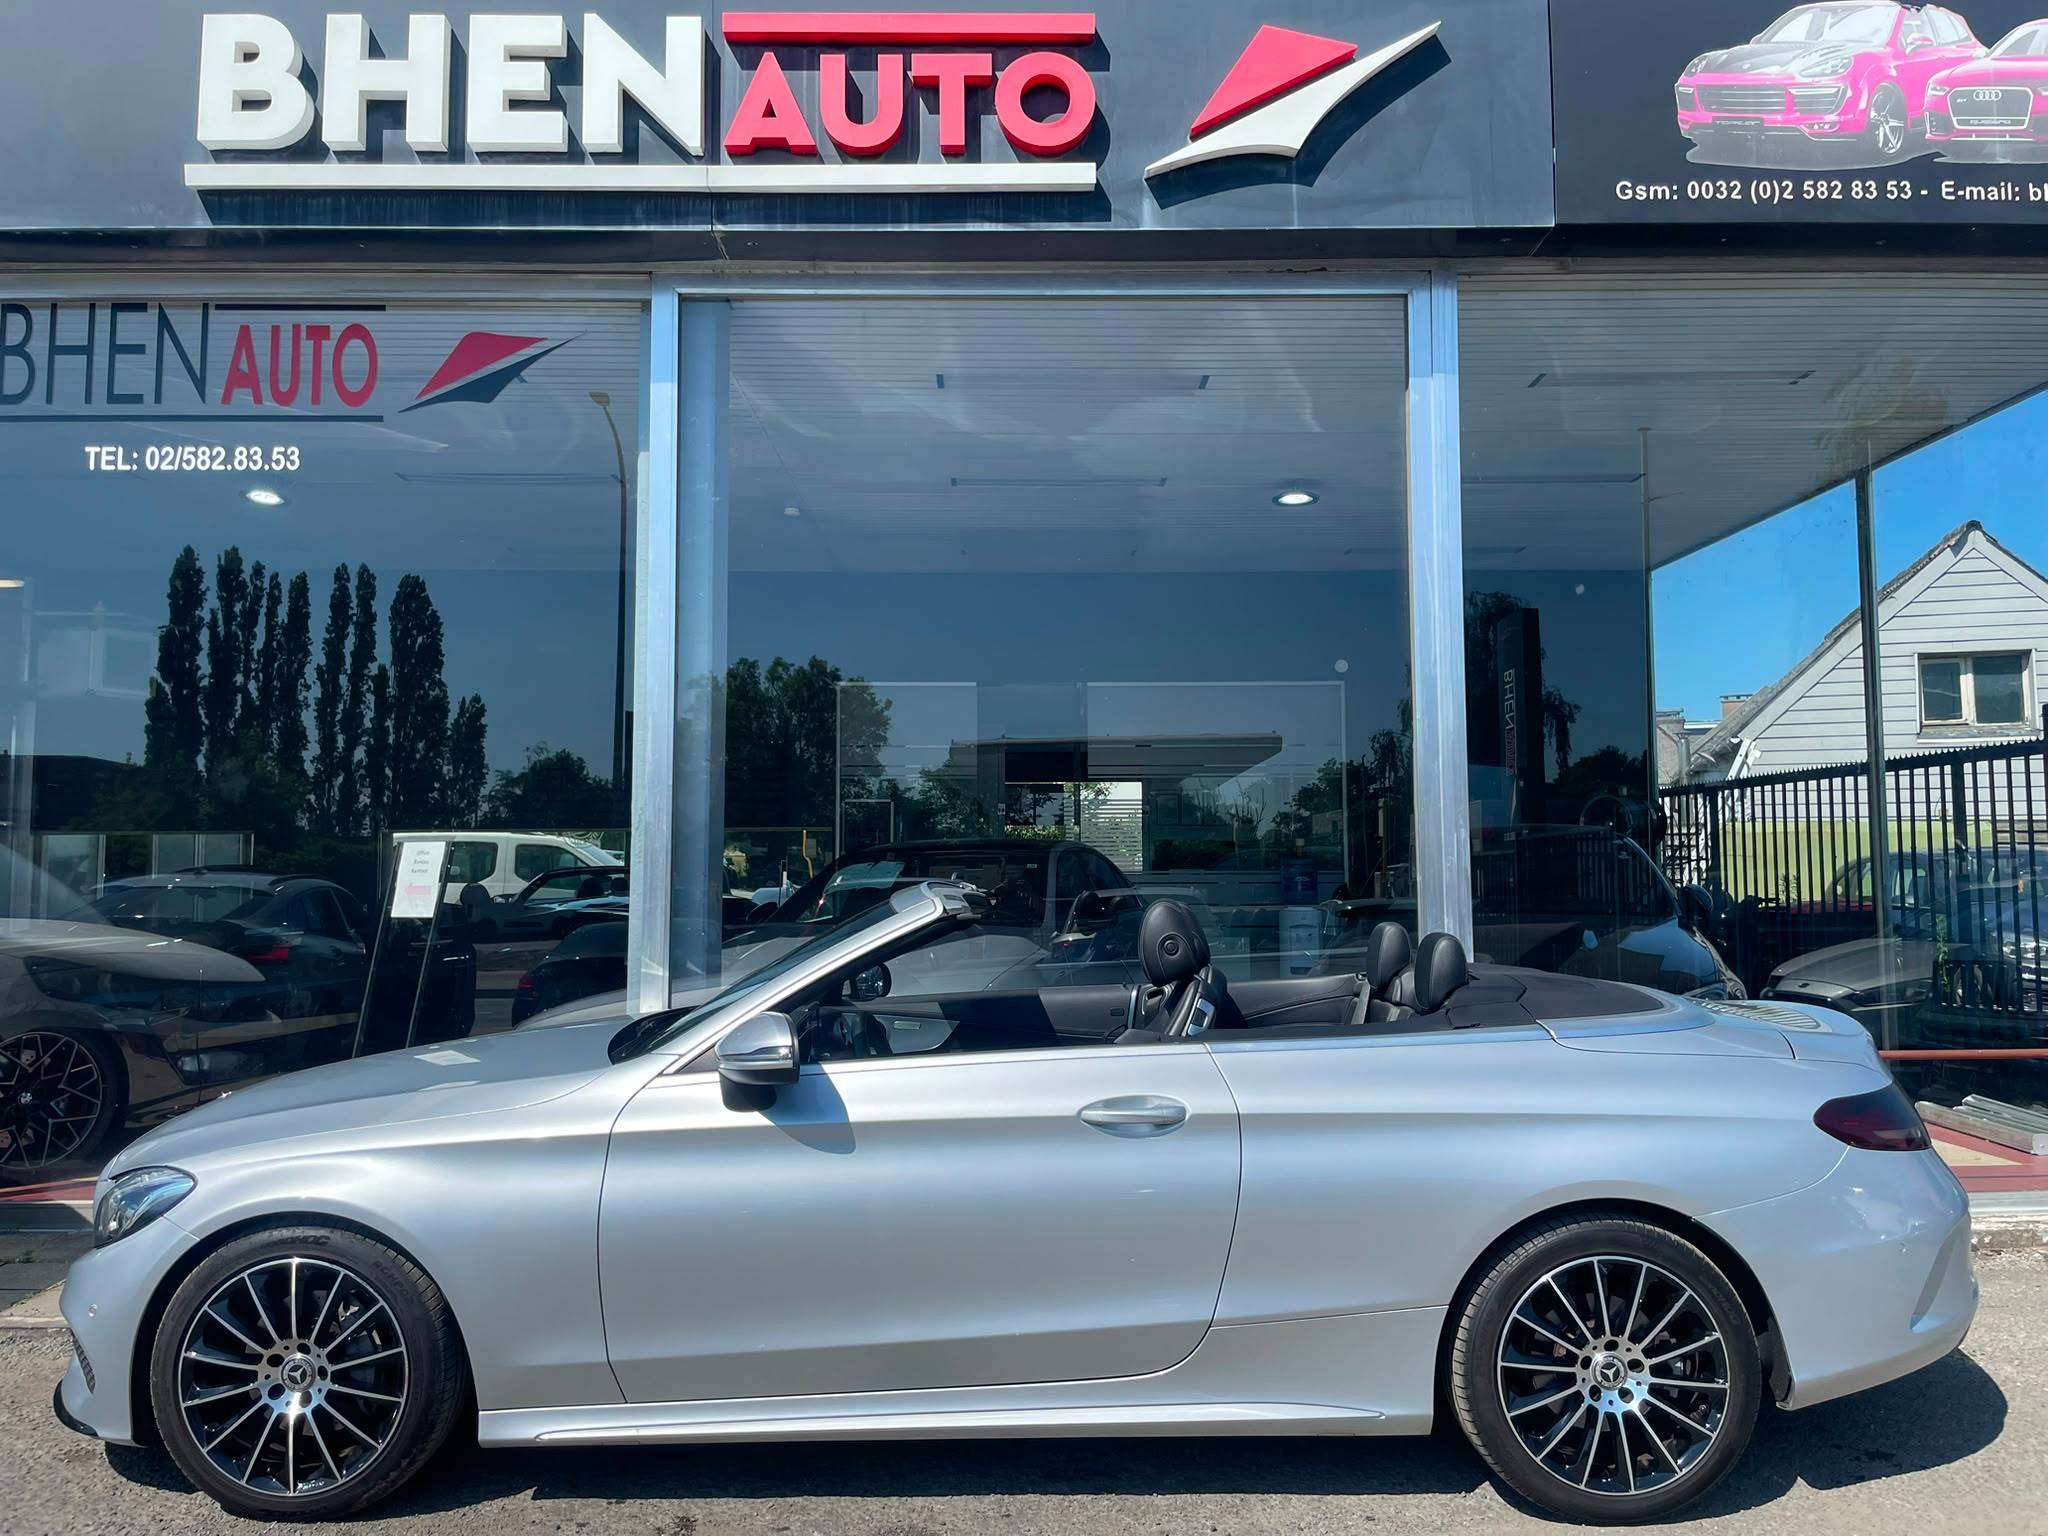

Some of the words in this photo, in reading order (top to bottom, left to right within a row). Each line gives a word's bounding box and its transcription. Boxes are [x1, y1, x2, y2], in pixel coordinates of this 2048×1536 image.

[1615, 181, 1678, 200] Gsm:
[1687, 181, 1742, 199] 0032
[1750, 180, 1794, 204] (0)2
[1803, 181, 1842, 199] 582
[1851, 181, 1878, 199] 83
[1886, 181, 1912, 199] 53
[1941, 181, 2020, 201] E-mail:
[85, 446, 138, 471] TEL:
[145, 446, 300, 471] 02/582.83.53
